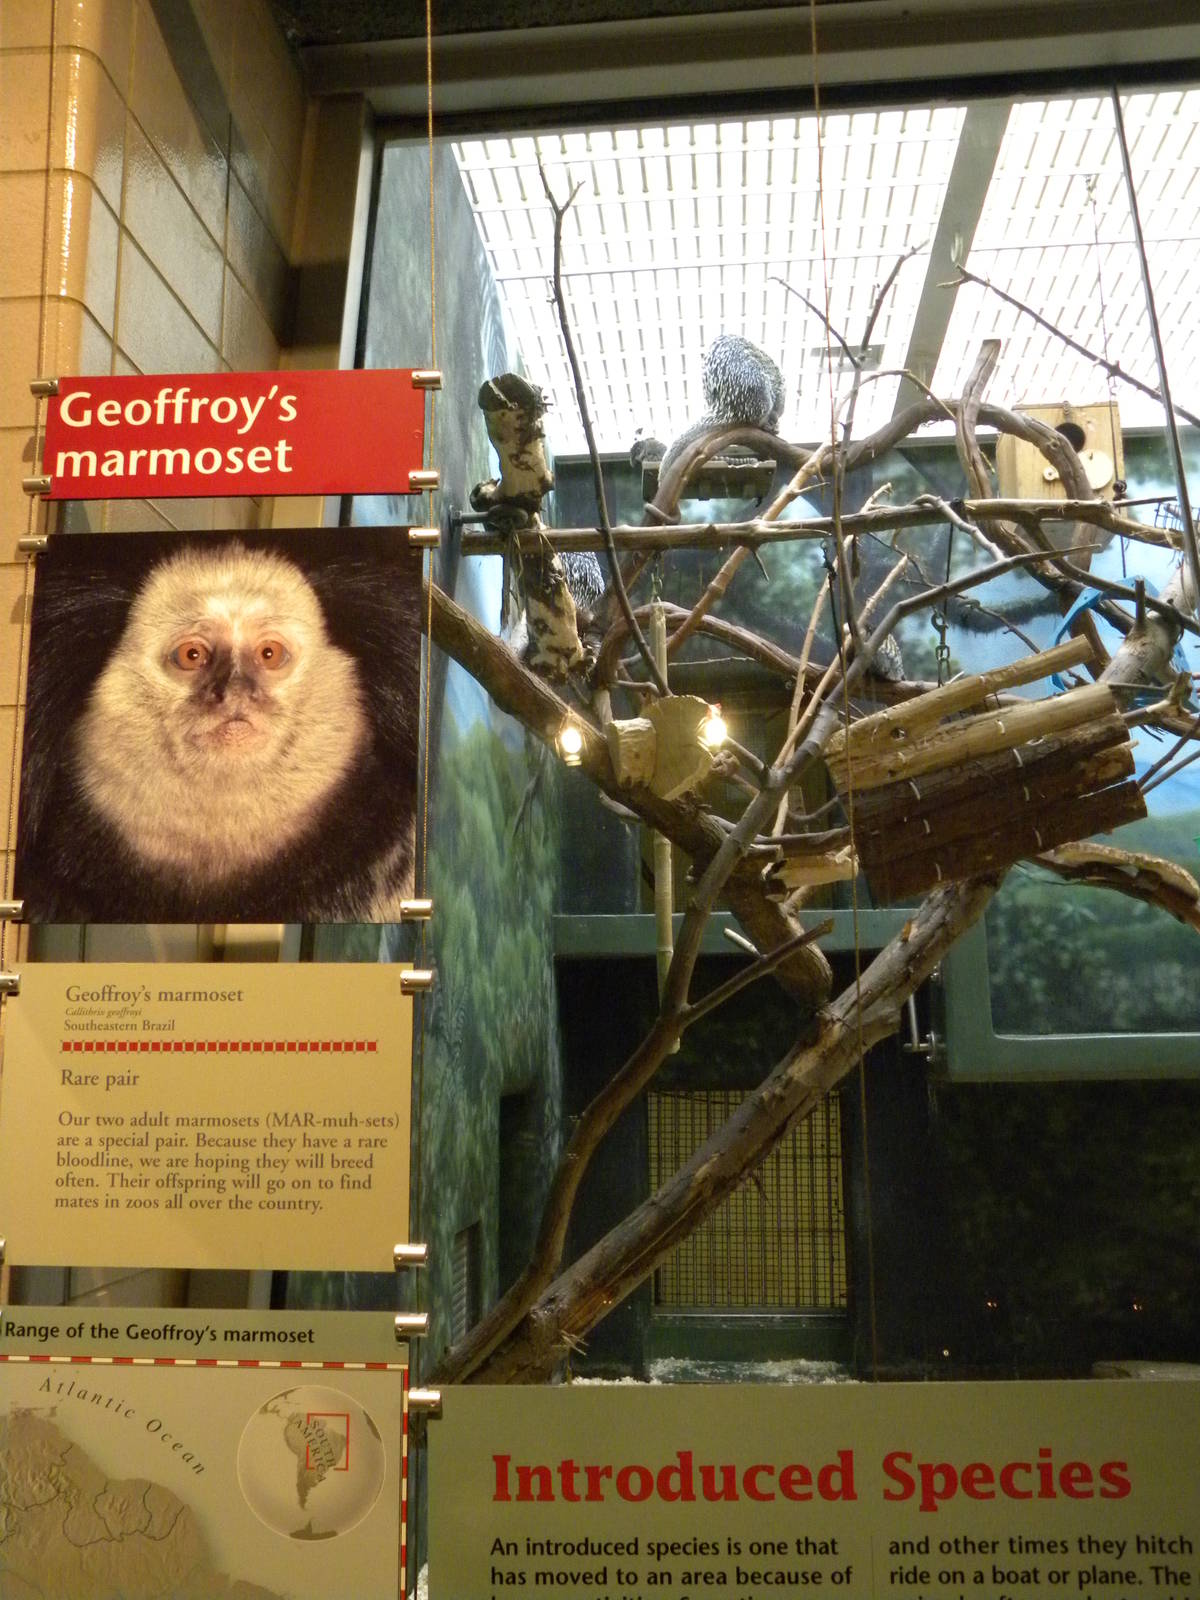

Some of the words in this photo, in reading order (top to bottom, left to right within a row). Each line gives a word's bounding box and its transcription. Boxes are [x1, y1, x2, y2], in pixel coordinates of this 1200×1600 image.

[59, 385, 298, 435] Geoffroy's
[56, 439, 293, 478] marmoset
[66, 985, 151, 1007] Geoffroy's
[158, 989, 244, 1002] marmoset
[64, 1019, 137, 1031] Southeastern
[142, 1019, 175, 1031] Brazil
[61, 1069, 99, 1086] Rare
[106, 1069, 139, 1091] pair
[58, 1111, 90, 1126] Our
[96, 1113, 124, 1126] two
[130, 1111, 170, 1127] adult
[176, 1114, 259, 1127] marmosets
[266, 1112, 400, 1129] (MAR-muh-sets)
[57, 1136, 79, 1146] are
[85, 1136, 92, 1146] a
[100, 1132, 149, 1150] special
[155, 1133, 188, 1151] pair.
[196, 1132, 257, 1148] Because
[263, 1132, 296, 1152] they
[302, 1133, 337, 1148] have
[344, 1138, 352, 1148] a
[358, 1138, 388, 1148] rare
[56, 1152, 133, 1168] bloodline,
[140, 1157, 160, 1168] we
[166, 1157, 188, 1168] are
[194, 1153, 250, 1173] hoping
[256, 1153, 289, 1173] they
[296, 1153, 324, 1168] will
[331, 1153, 373, 1169] breed
[55, 1172, 99, 1188] often.
[107, 1173, 150, 1188] Their
[155, 1173, 226, 1193] offspring
[232, 1174, 260, 1189] will
[267, 1178, 285, 1194] go
[292, 1178, 311, 1189] on
[318, 1177, 334, 1189] to
[340, 1174, 372, 1190] find
[55, 1197, 99, 1208] mates
[105, 1194, 119, 1208] in
[126, 1198, 159, 1208] zoos
[165, 1194, 183, 1209] all
[189, 1198, 222, 1209] over
[228, 1194, 252, 1209] the
[258, 1198, 323, 1214] country.
[5, 1322, 59, 1342] Range
[67, 1323, 85, 1338] of
[90, 1324, 119, 1339] the
[126, 1324, 217, 1345] Geoffroy's
[223, 1328, 315, 1343] marmoset
[39, 1376, 135, 1419] Atlantic
[146, 1419, 205, 1474] Ocean
[492, 1450, 858, 1502] Introduced
[882, 1447, 1132, 1512] Species
[490, 1538, 518, 1556] An
[526, 1538, 639, 1556] introduced
[647, 1538, 719, 1561] species
[727, 1538, 742, 1555] is
[749, 1541, 788, 1555] one
[796, 1537, 839, 1555] that
[889, 1536, 929, 1555] and
[939, 1536, 1000, 1554] other
[1008, 1536, 1069, 1555] times
[1078, 1536, 1127, 1559] they
[1136, 1535, 1193, 1555] hitch
[491, 1566, 526, 1585] has
[535, 1566, 608, 1585] moved
[616, 1570, 638, 1585] to
[647, 1571, 672, 1585] an
[681, 1571, 727, 1585] area
[736, 1566, 823, 1585] because
[831, 1566, 852, 1585] of
[890, 1566, 930, 1585] ride
[938, 1570, 965, 1585] on
[973, 1570, 984, 1585] a
[992, 1566, 1040, 1584] boat
[1047, 1570, 1070, 1584] or
[1078, 1565, 1143, 1589] plane.
[1149, 1566, 1192, 1585] The
